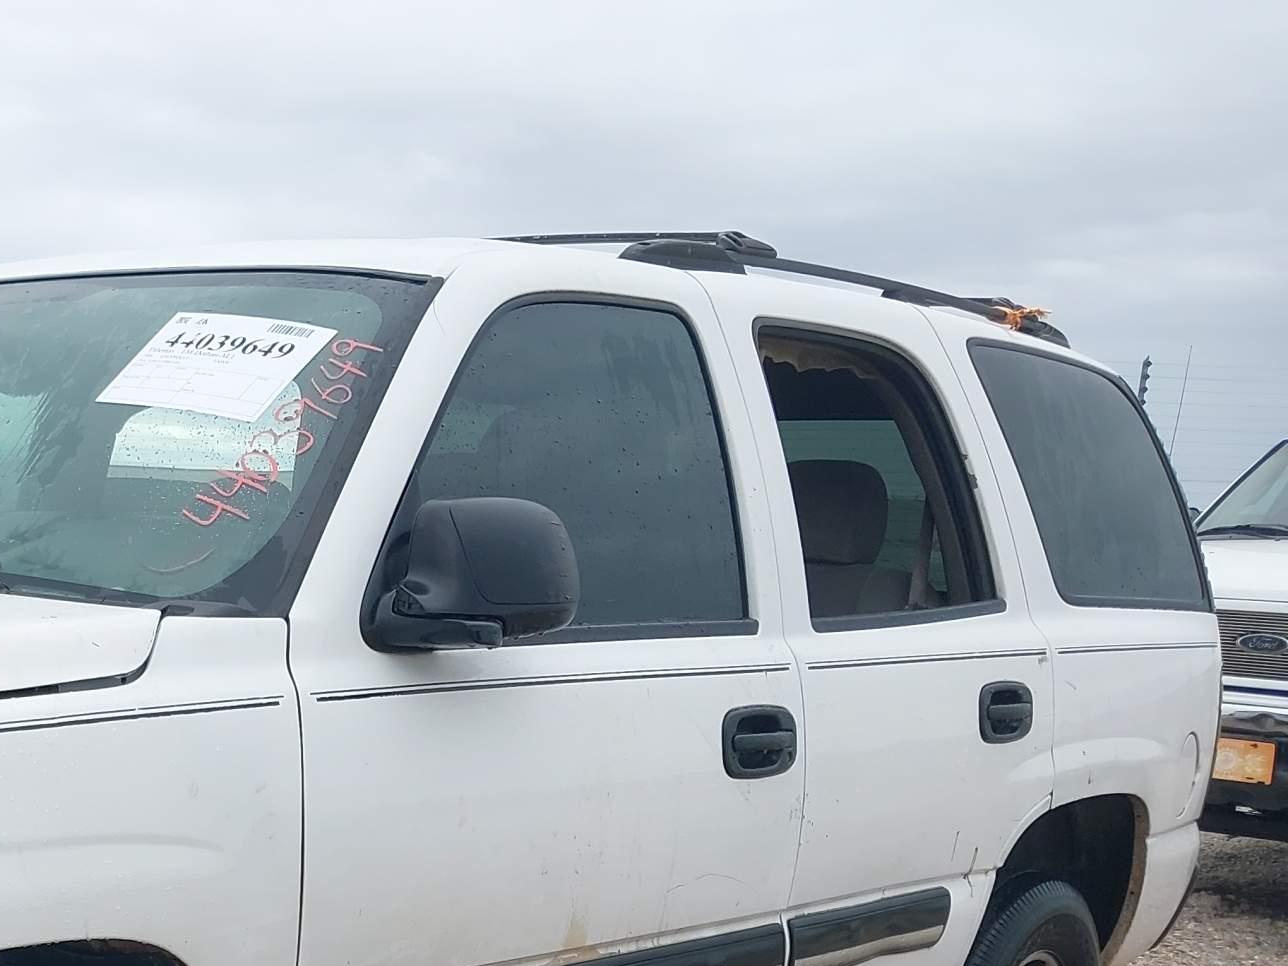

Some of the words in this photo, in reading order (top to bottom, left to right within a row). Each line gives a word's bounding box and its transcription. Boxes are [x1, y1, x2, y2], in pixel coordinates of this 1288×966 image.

[165, 331, 295, 359] 44039649
[182, 339, 383, 526] 44039649
[1248, 637, 1279, 649] Ford
